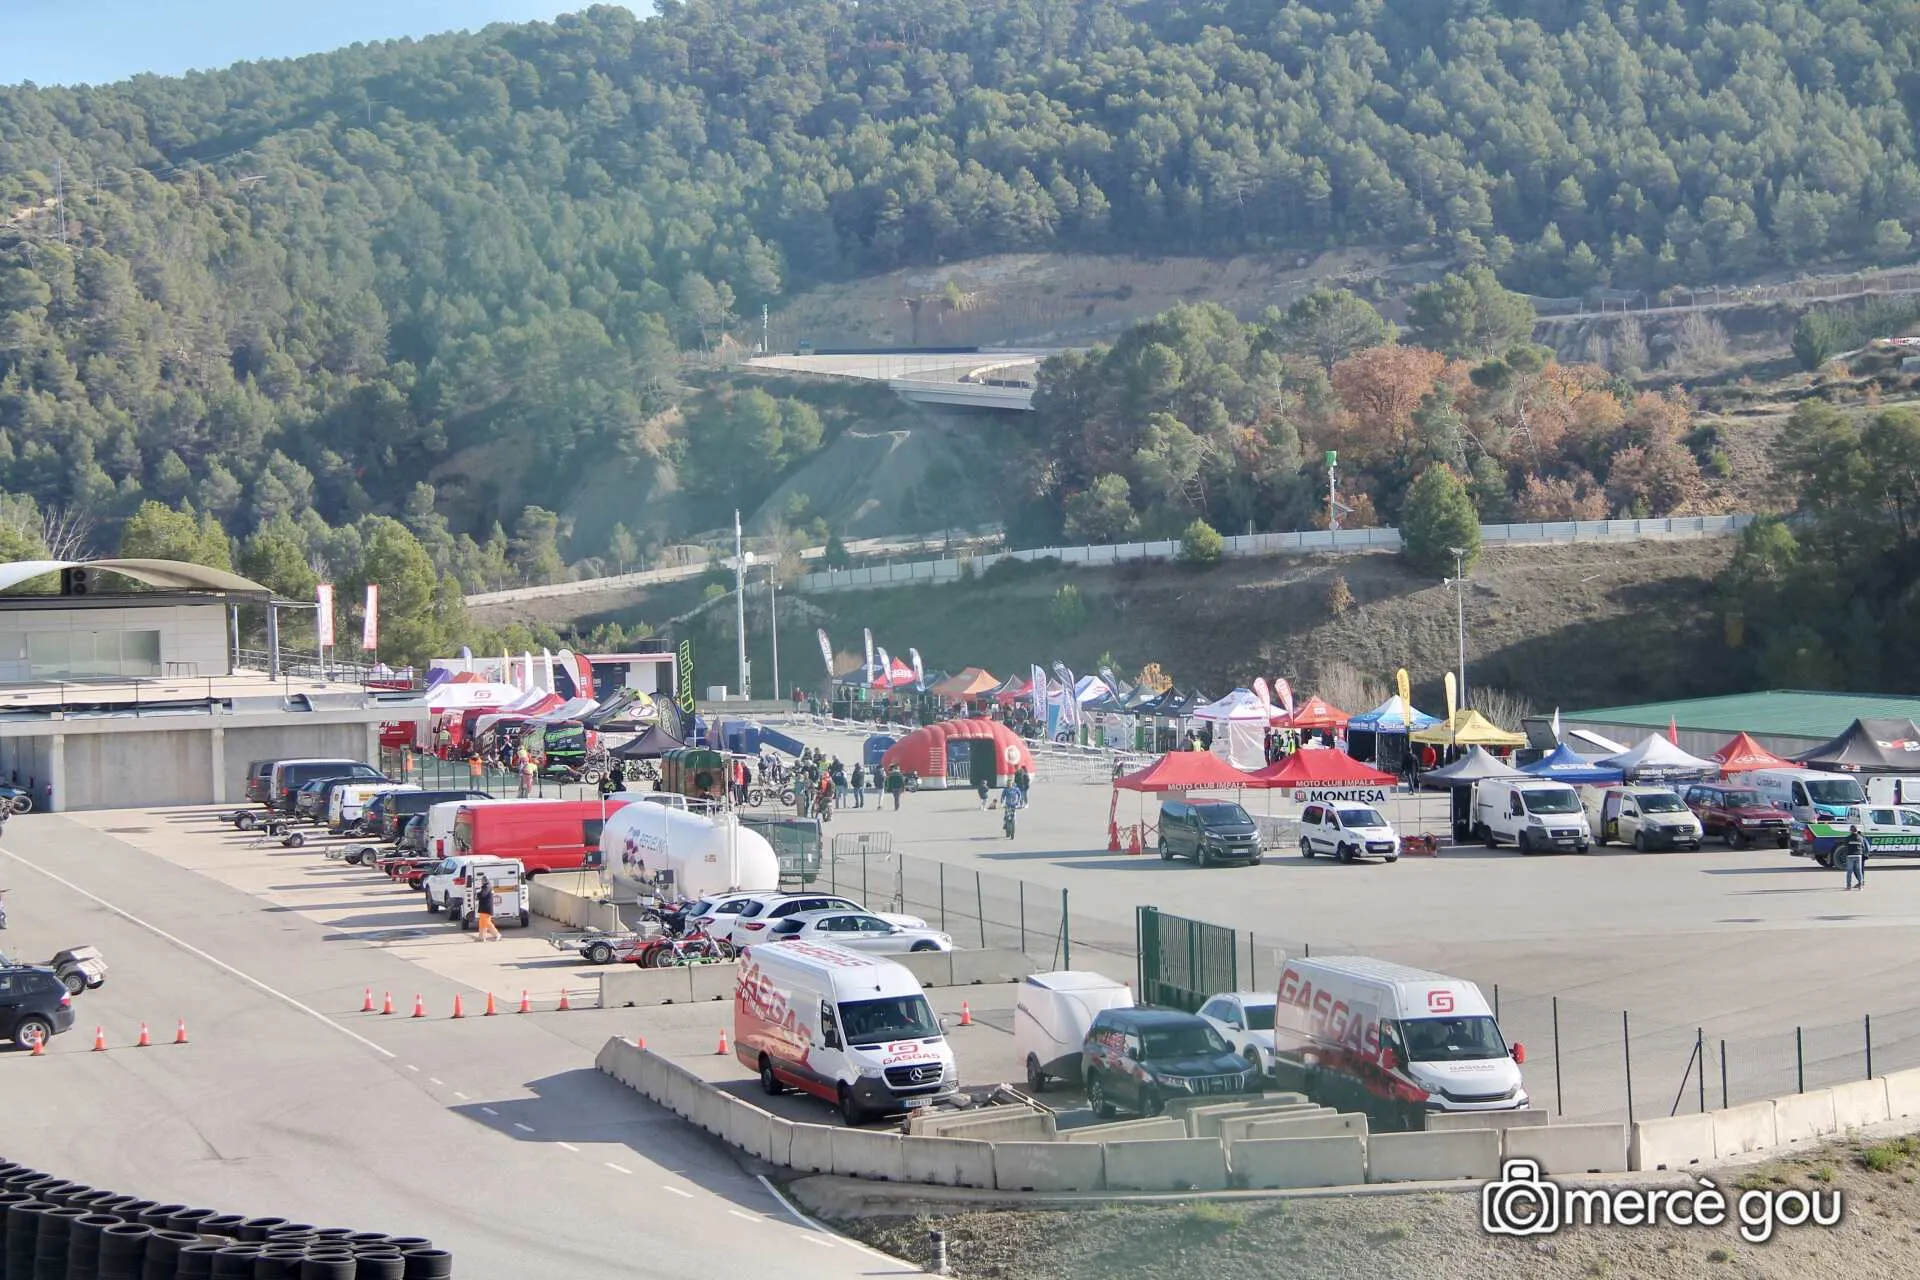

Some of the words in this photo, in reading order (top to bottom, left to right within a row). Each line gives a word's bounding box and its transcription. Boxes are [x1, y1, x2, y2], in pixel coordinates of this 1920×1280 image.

[1168, 783, 1192, 791] MOTO
[1216, 782, 1247, 790] IMPALA
[1296, 780, 1320, 788] MOTO
[1345, 779, 1375, 787] IMPALA
[1310, 790, 1385, 801] MONTESA
[1277, 967, 1380, 1060] GASGAS
[882, 1053, 941, 1065] GASGAS
